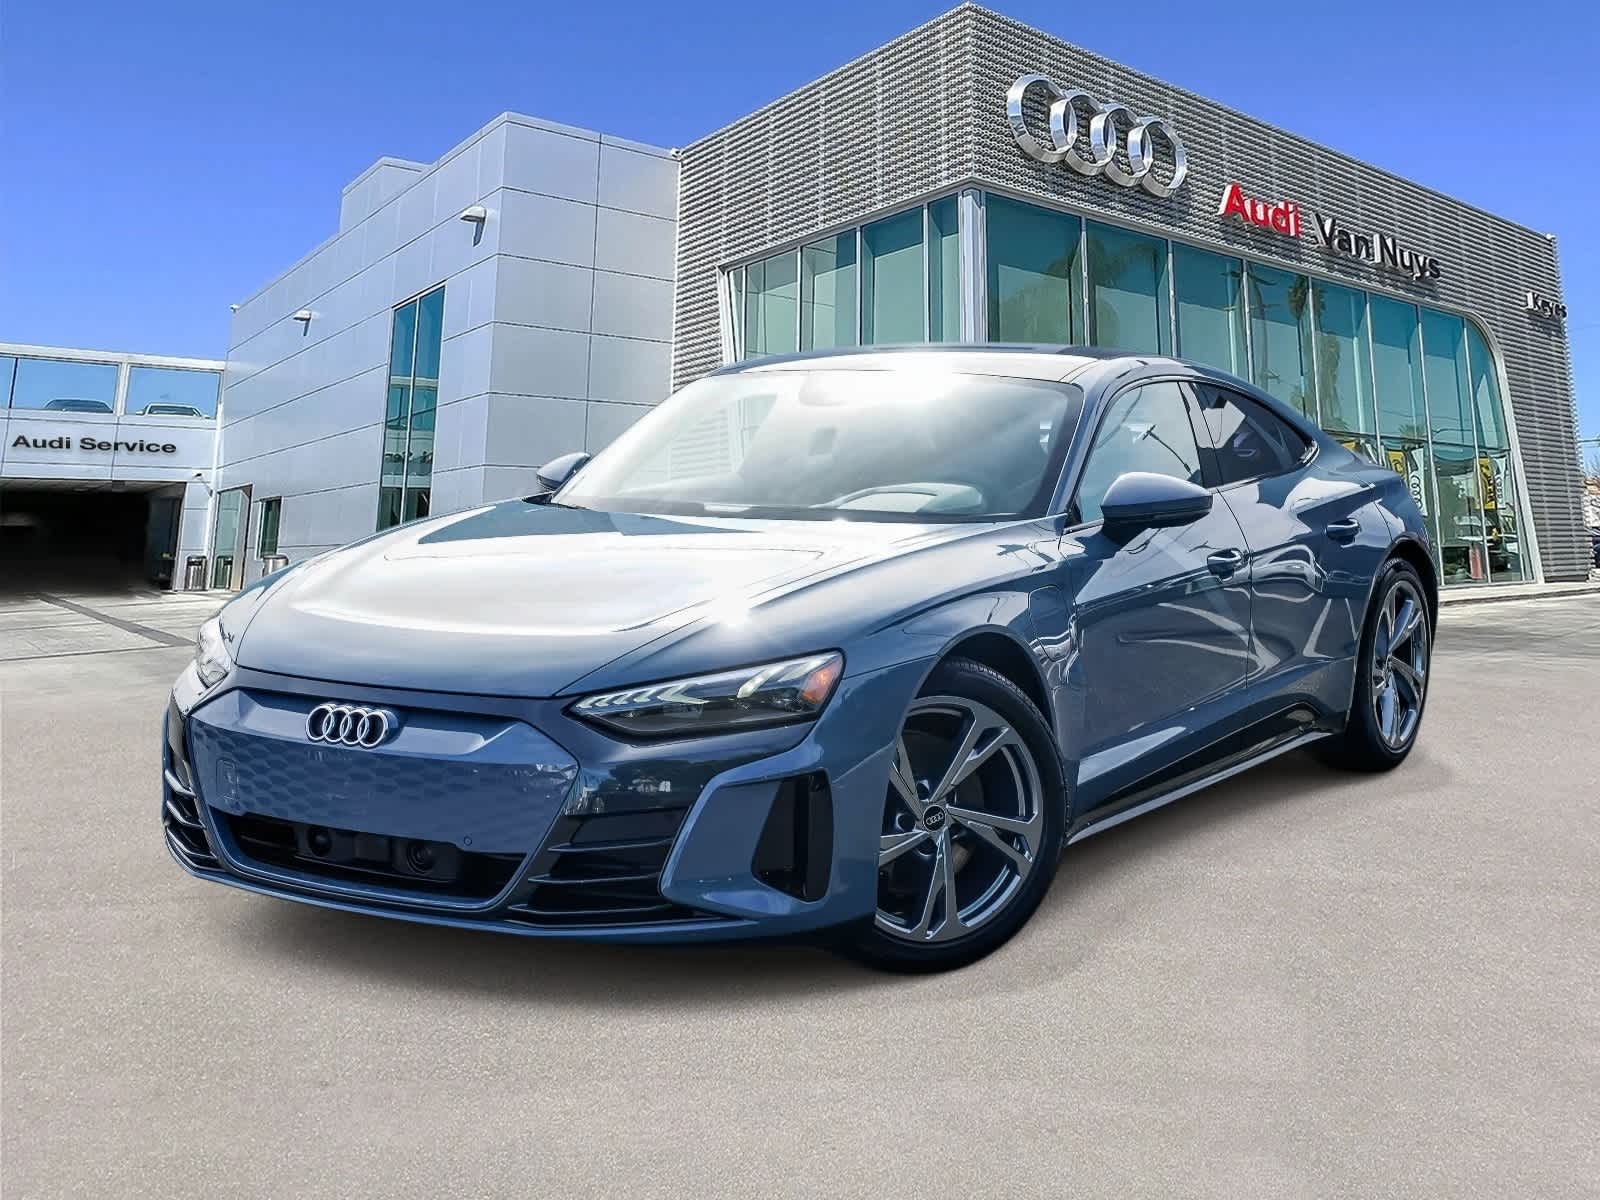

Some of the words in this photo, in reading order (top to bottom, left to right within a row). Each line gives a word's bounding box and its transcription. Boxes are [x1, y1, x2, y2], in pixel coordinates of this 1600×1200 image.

[1218, 181, 1301, 237] Audi
[1311, 212, 1370, 258] Van
[1373, 233, 1441, 280] Nuys
[12, 435, 71, 449] Audi
[79, 437, 177, 453] Service
